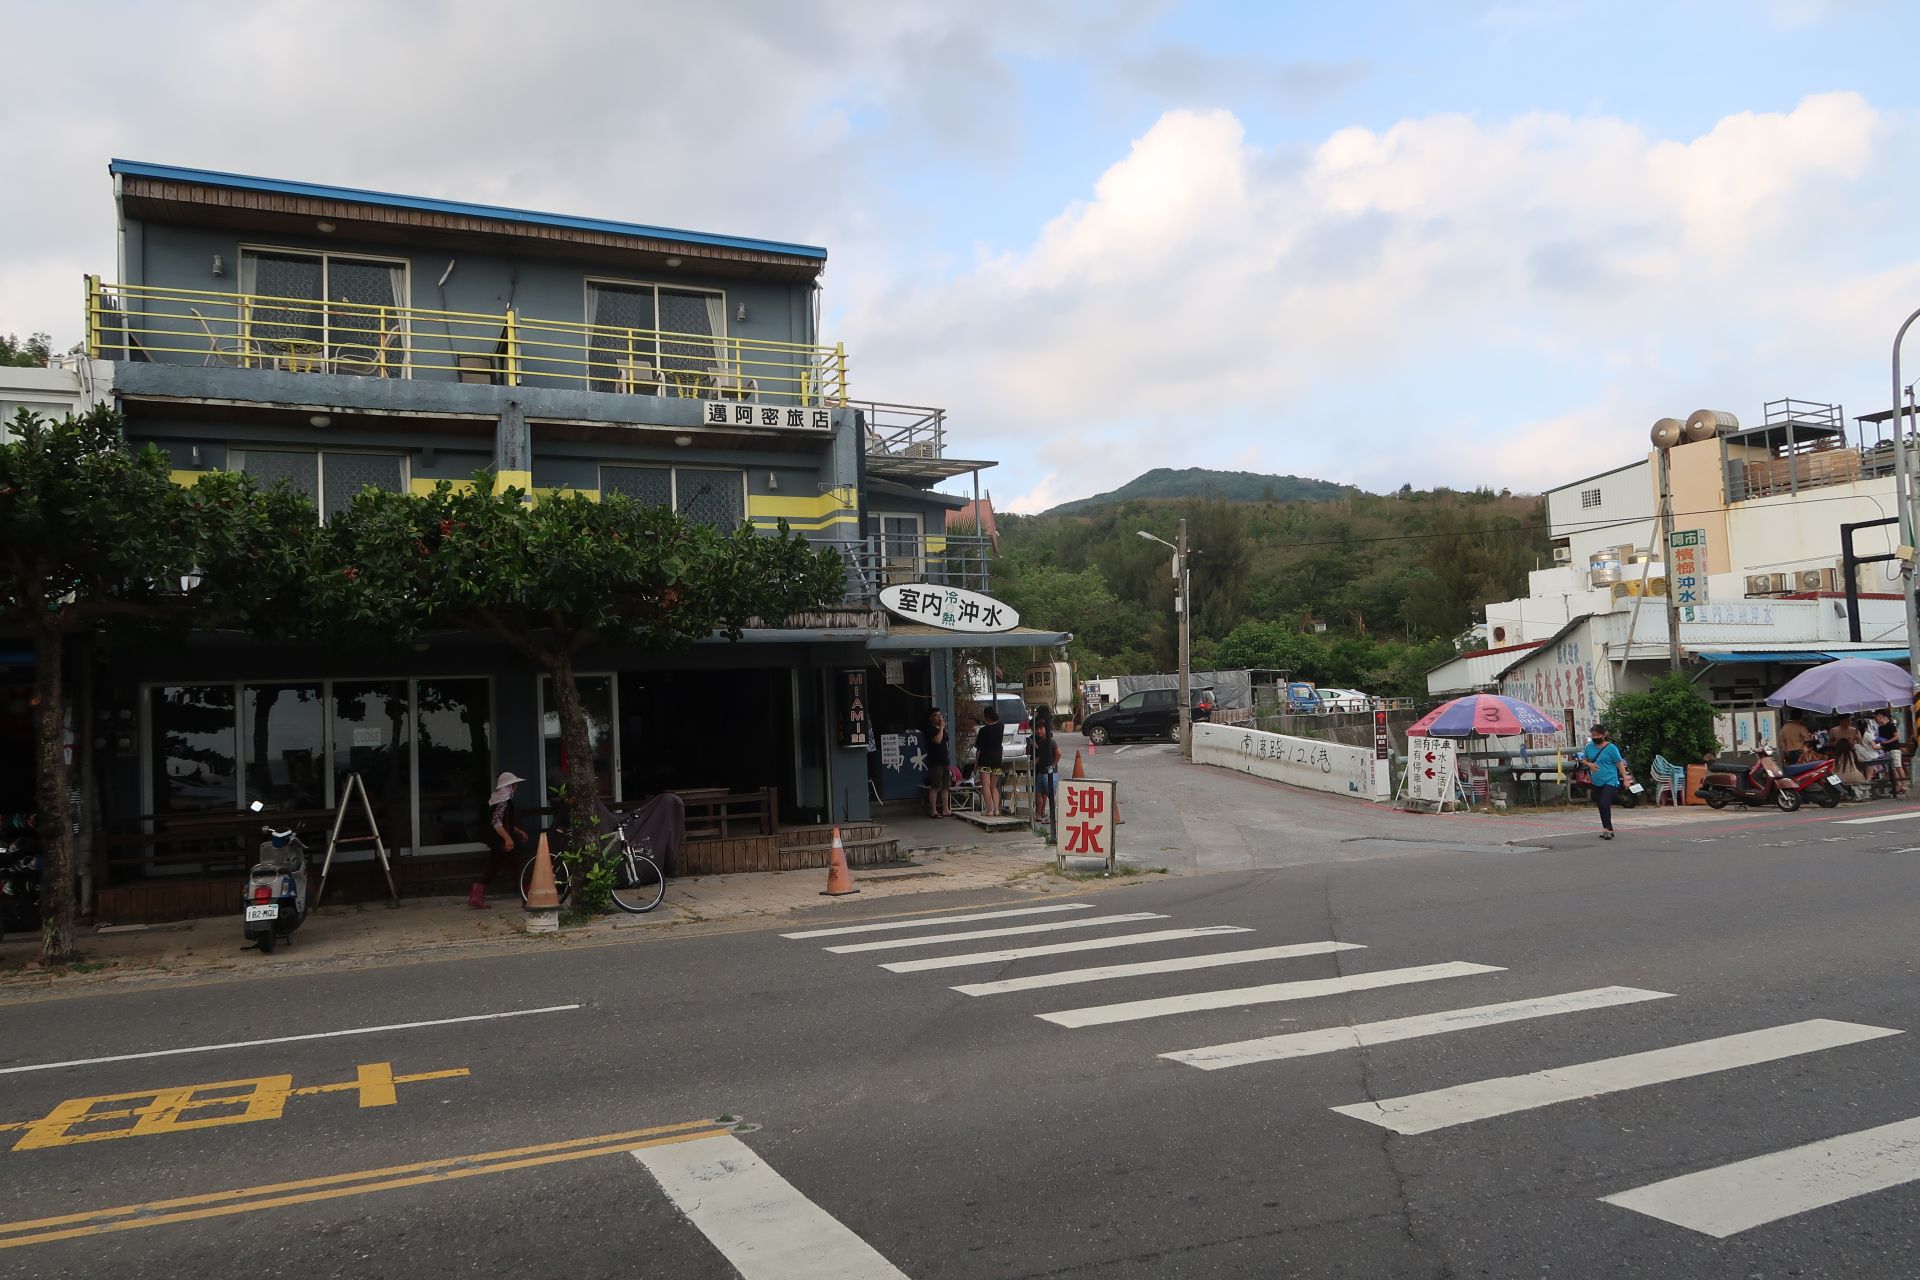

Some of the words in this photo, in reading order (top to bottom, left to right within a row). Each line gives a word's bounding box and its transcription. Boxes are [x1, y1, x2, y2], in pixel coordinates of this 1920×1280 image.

[708, 403, 830, 429] 邁阿密旅店
[848, 673, 866, 734] MIAMI
[1482, 707, 1500, 723] 3
[1065, 785, 1104, 854] 沖水
